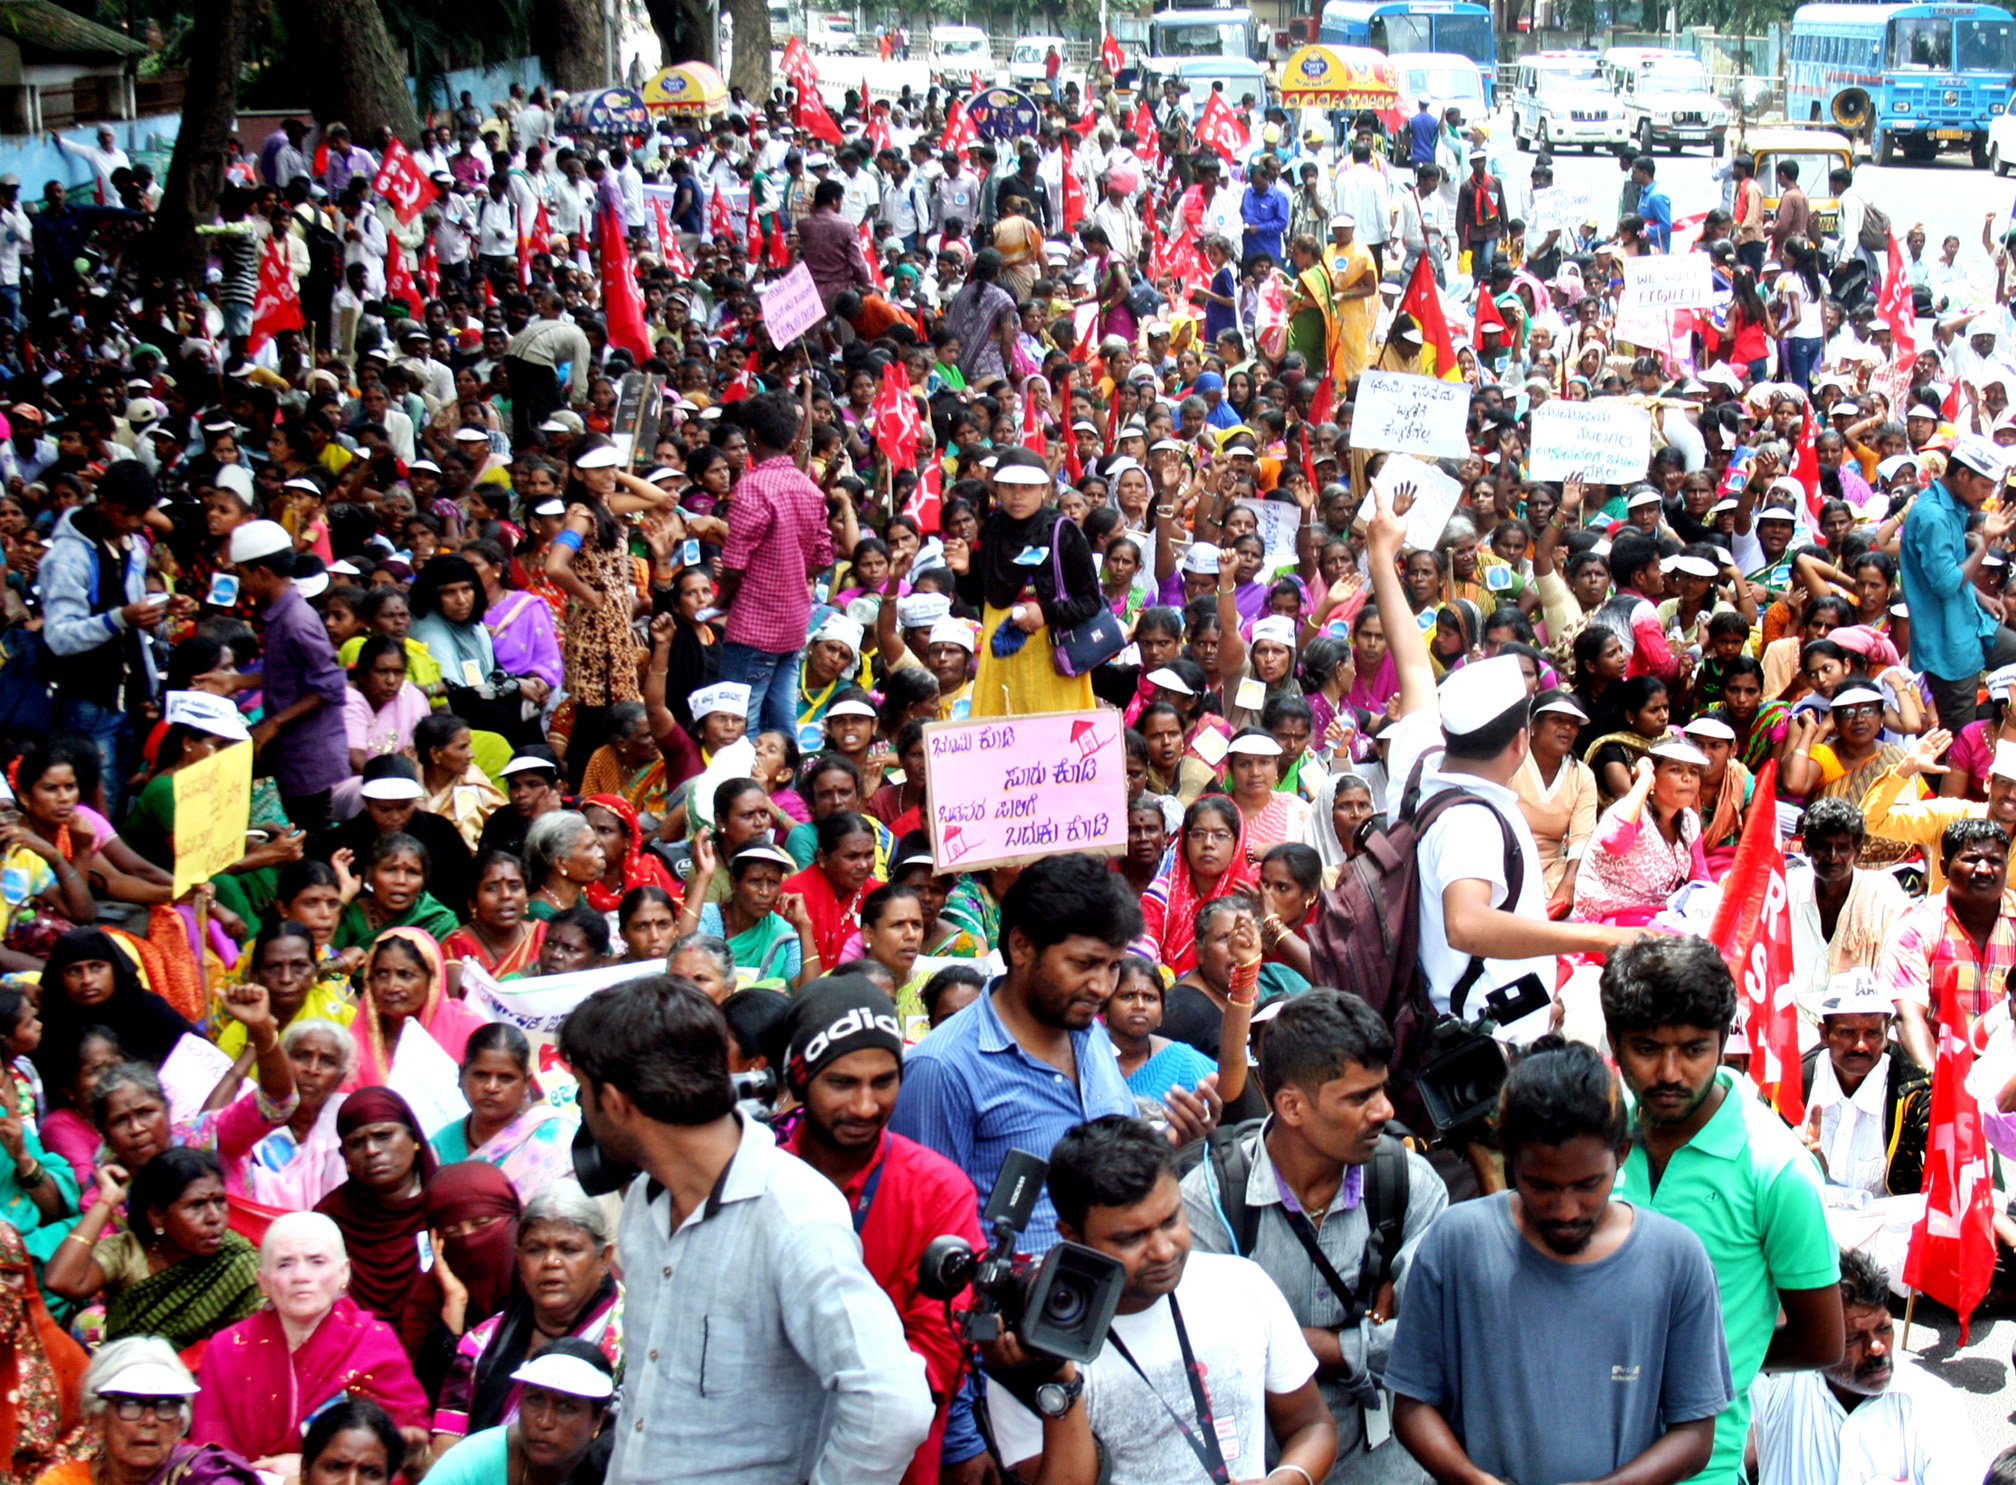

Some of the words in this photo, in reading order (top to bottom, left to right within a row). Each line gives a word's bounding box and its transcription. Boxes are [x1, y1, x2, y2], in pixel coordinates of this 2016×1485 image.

[1204, 102, 1226, 141] KRS
[376, 144, 408, 192] KRS
[932, 733, 972, 757] ಭೂಮಿ
[1004, 761, 1046, 790] ಸೂರು
[1005, 818, 1058, 847] ಬದುಕು
